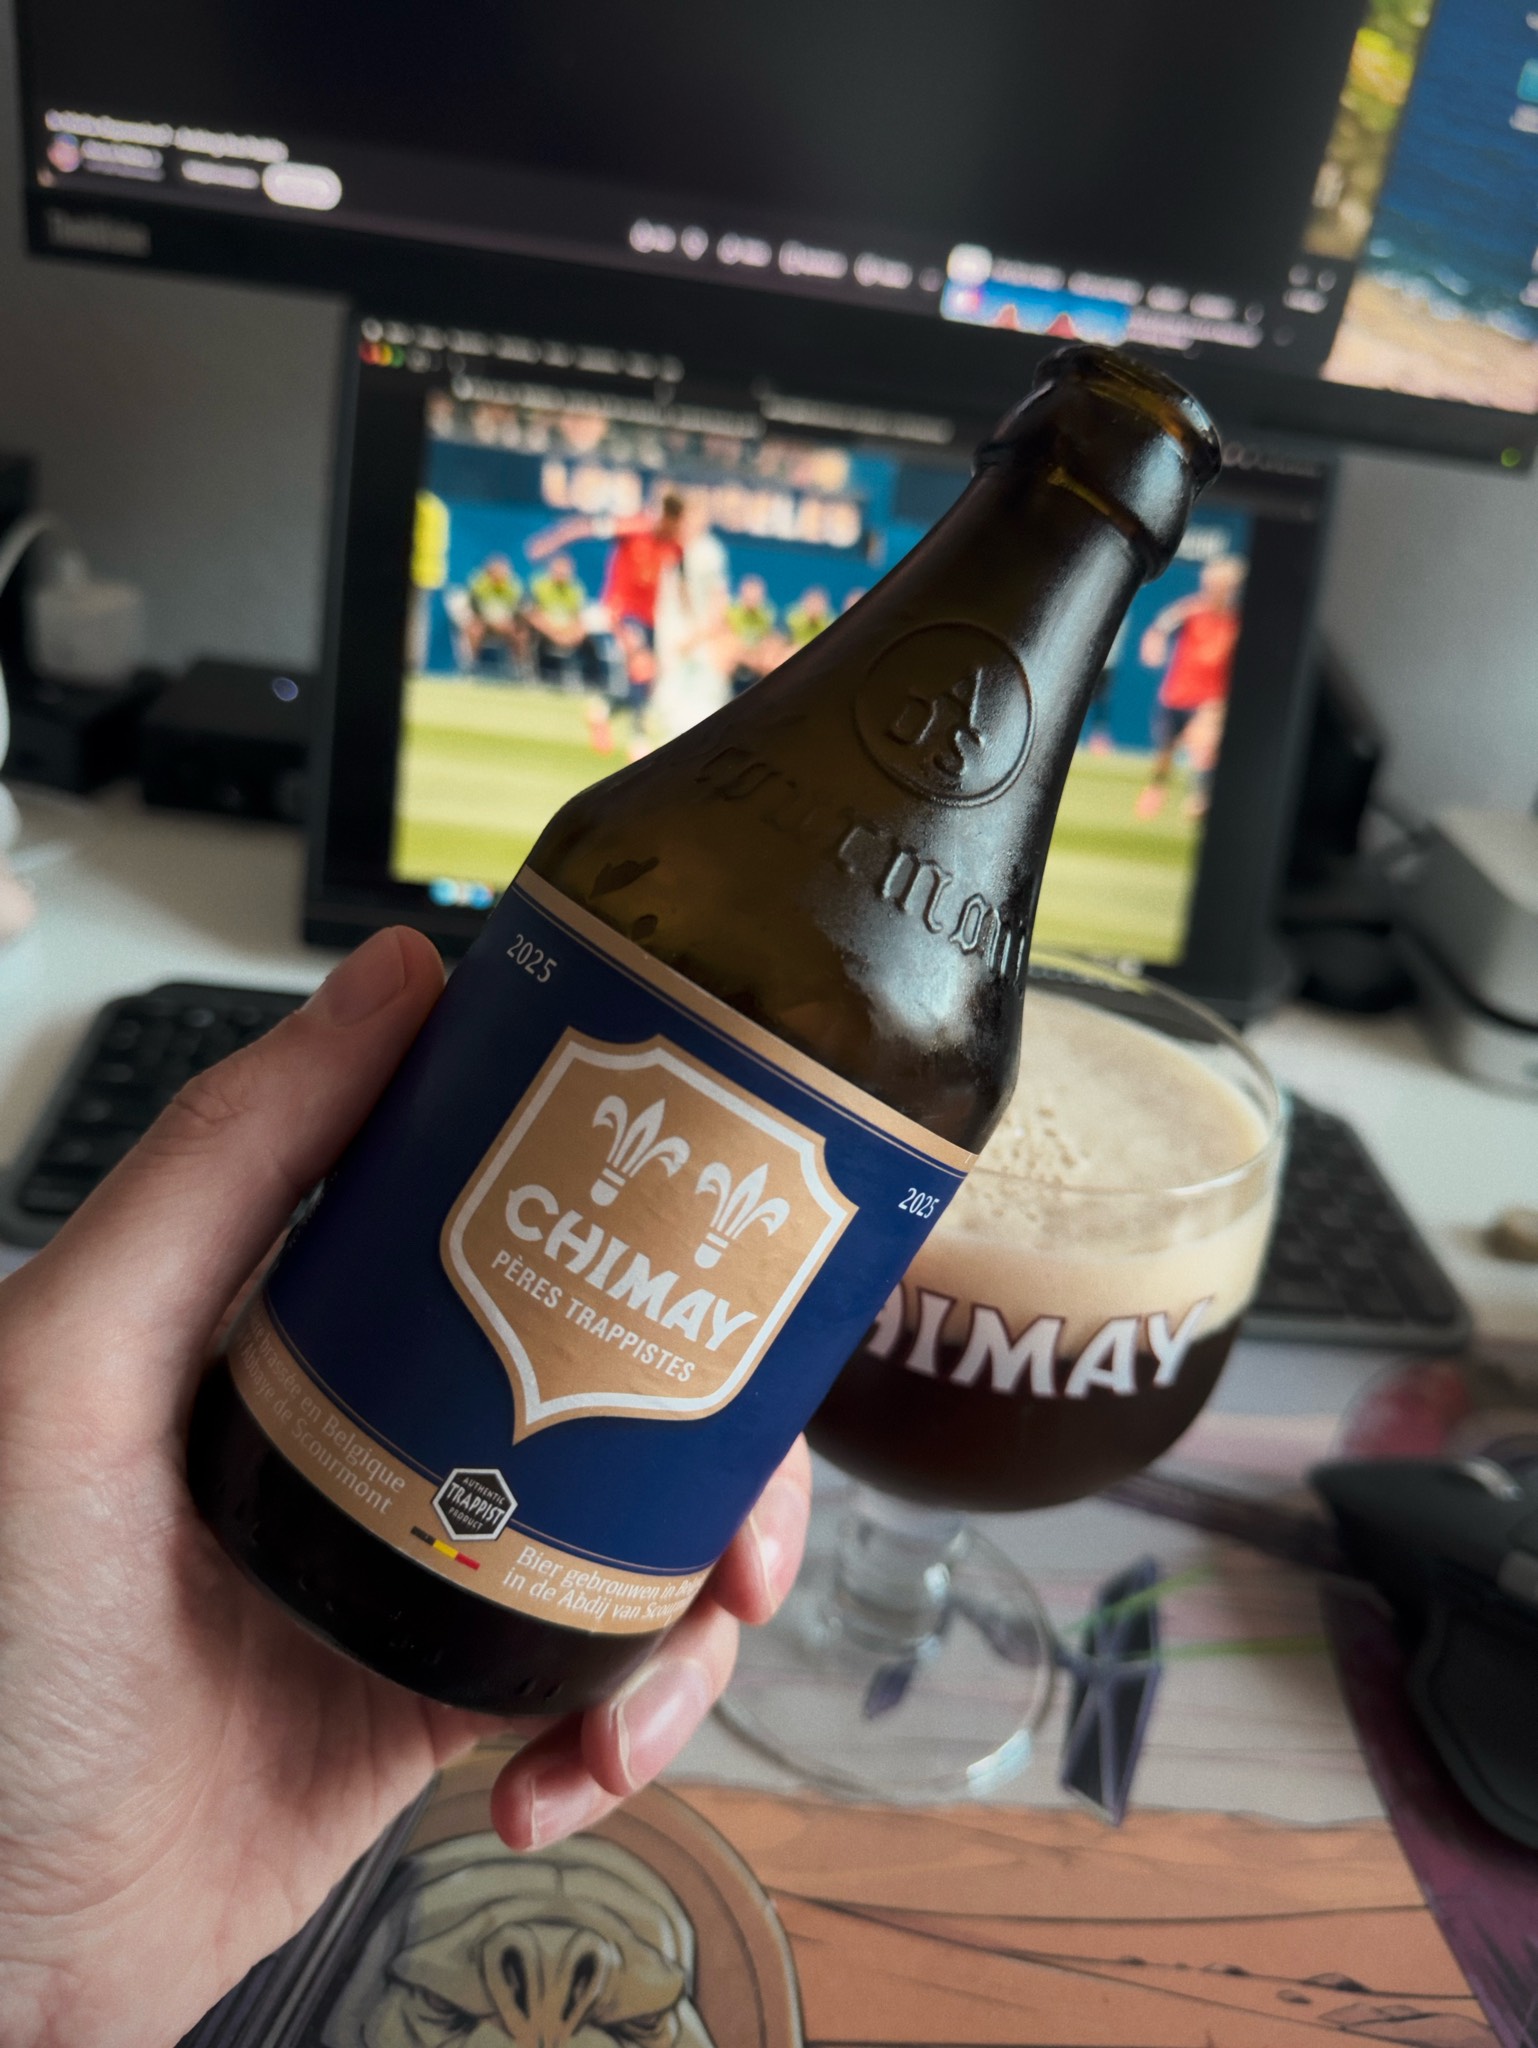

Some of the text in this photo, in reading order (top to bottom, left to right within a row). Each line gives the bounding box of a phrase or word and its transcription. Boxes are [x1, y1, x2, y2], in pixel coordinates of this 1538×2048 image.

[505, 933, 558, 983] 2025
[897, 1187, 940, 1219] 2025
[491, 1249, 563, 1309] PÈRES
[505, 1184, 758, 1351] CHIMAY
[565, 1297, 696, 1383] TRAPPISTES
[865, 1280, 1214, 1399] IMAY
[259, 1331, 406, 1493] brassée en Belgique
[273, 1398, 294, 1425] de
[290, 1417, 393, 1515] Scourmont
[446, 1481, 506, 1525] TRAPPIST
[448, 1506, 484, 1532] PRODUCT
[462, 1477, 506, 1505] AUTHENTIC
[502, 1567, 527, 1591] in
[528, 1579, 557, 1601] de
[556, 1588, 613, 1620] Abdij
[612, 1603, 642, 1620] van
[516, 1545, 563, 1577] Bier
[560, 1568, 660, 1601] gebrouwen
[659, 1581, 676, 1599] in
